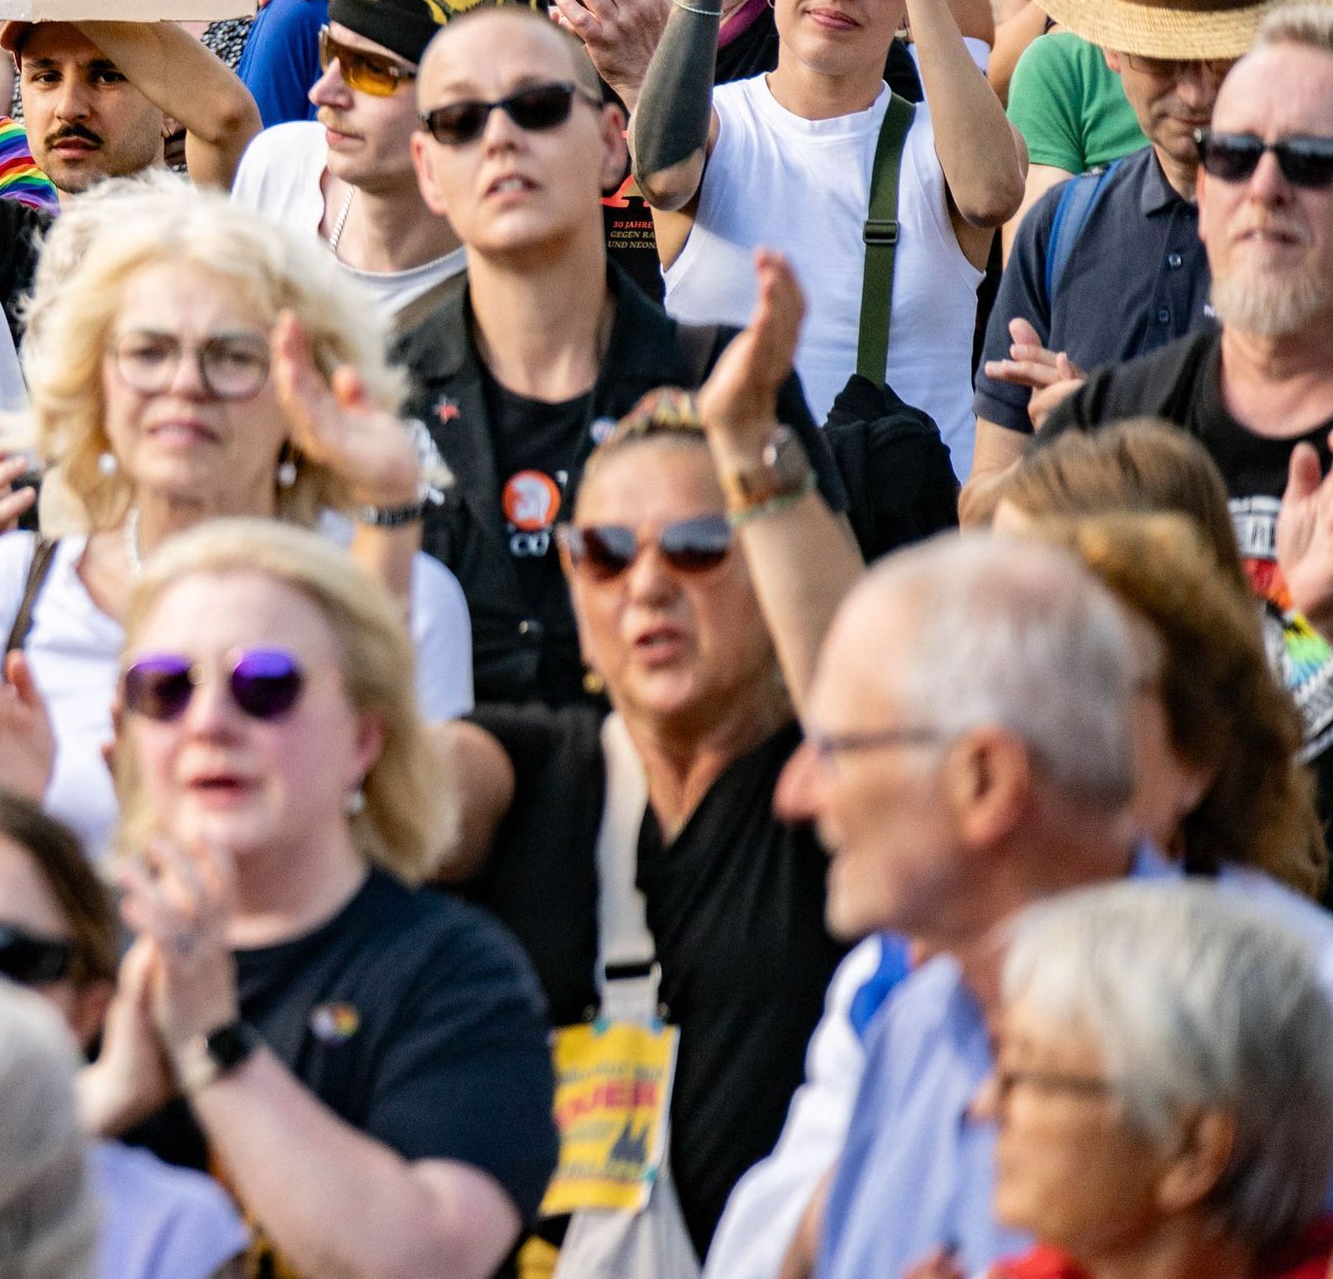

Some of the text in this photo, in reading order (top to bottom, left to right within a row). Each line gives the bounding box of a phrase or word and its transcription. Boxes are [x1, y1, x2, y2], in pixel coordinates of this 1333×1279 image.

[613, 220, 654, 230] 30 JAHRE
[610, 230, 641, 239] GEGEN
[607, 240, 628, 249] UND
